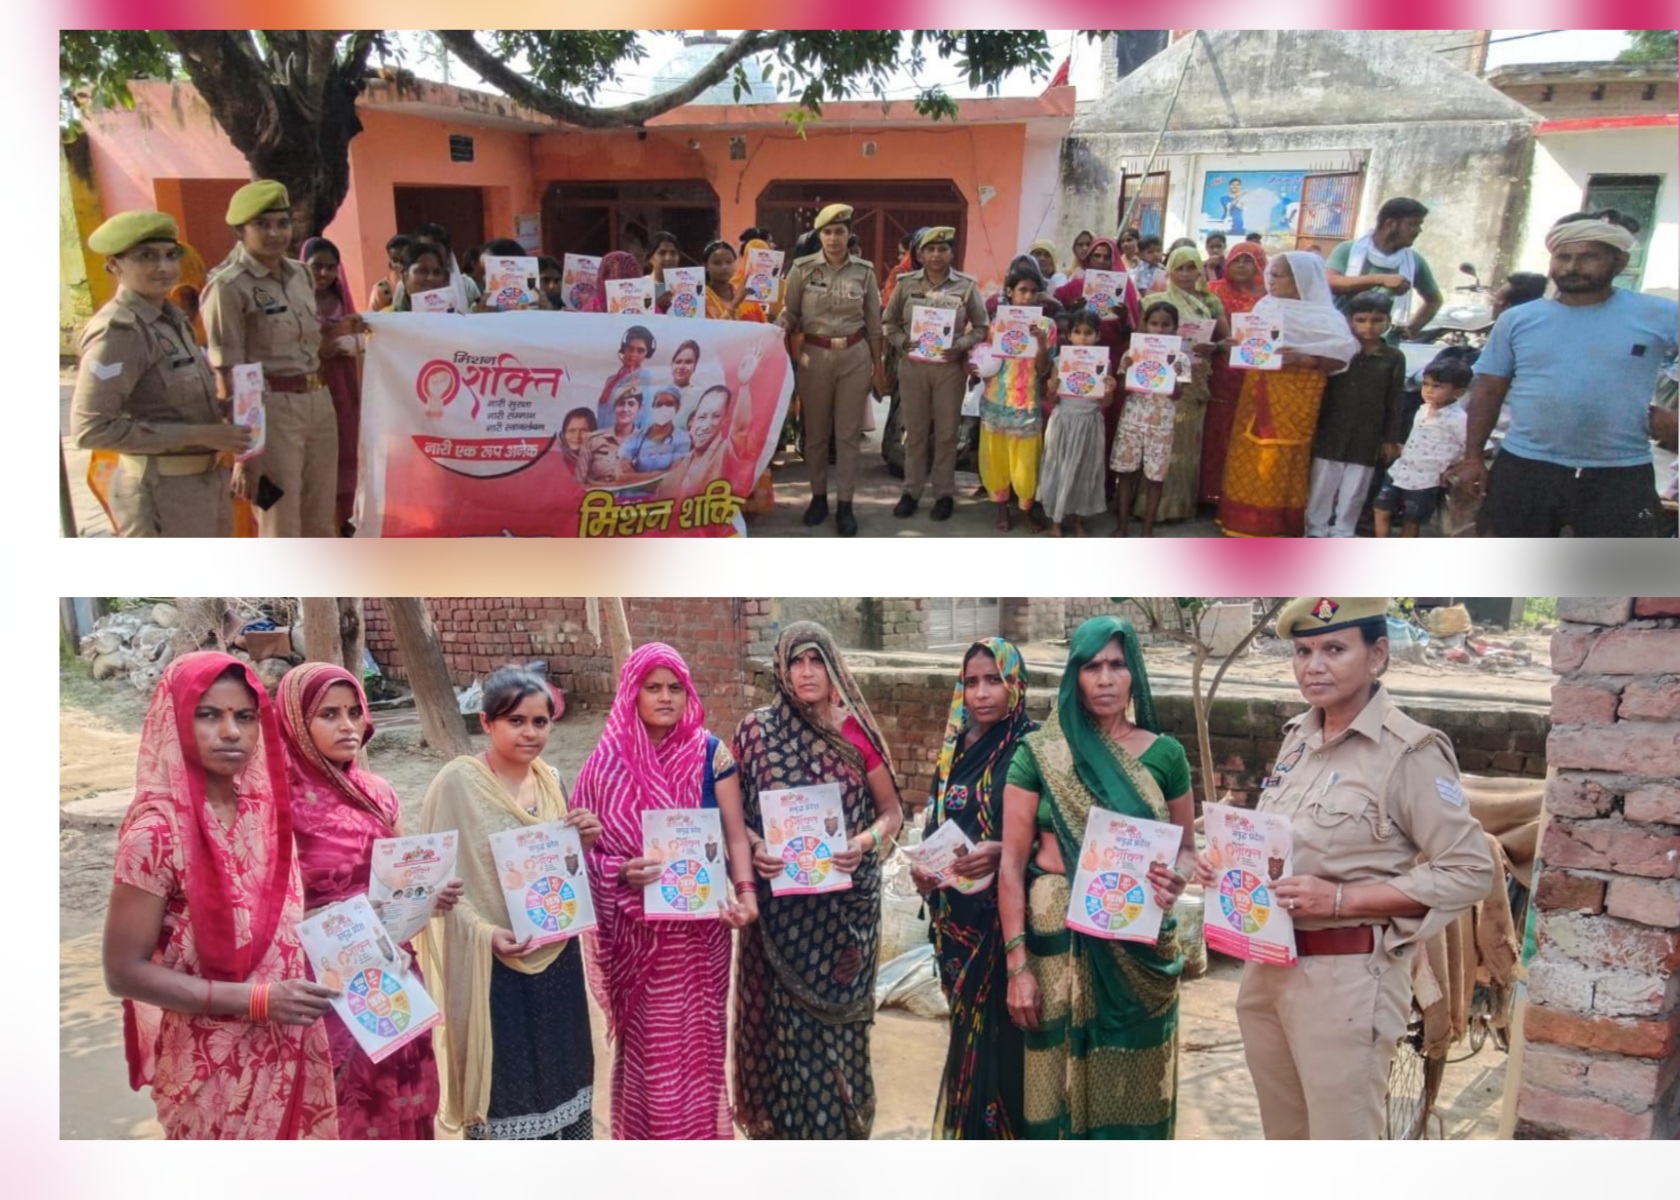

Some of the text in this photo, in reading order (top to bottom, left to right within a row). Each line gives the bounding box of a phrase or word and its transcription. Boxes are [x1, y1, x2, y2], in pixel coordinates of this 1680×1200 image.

[453, 350, 496, 365] मिशन
[462, 353, 563, 421] शक्ति
[424, 439, 452, 456] नारी
[455, 444, 477, 457] एक
[504, 440, 539, 458] अनेक
[577, 488, 674, 538] मिशन
